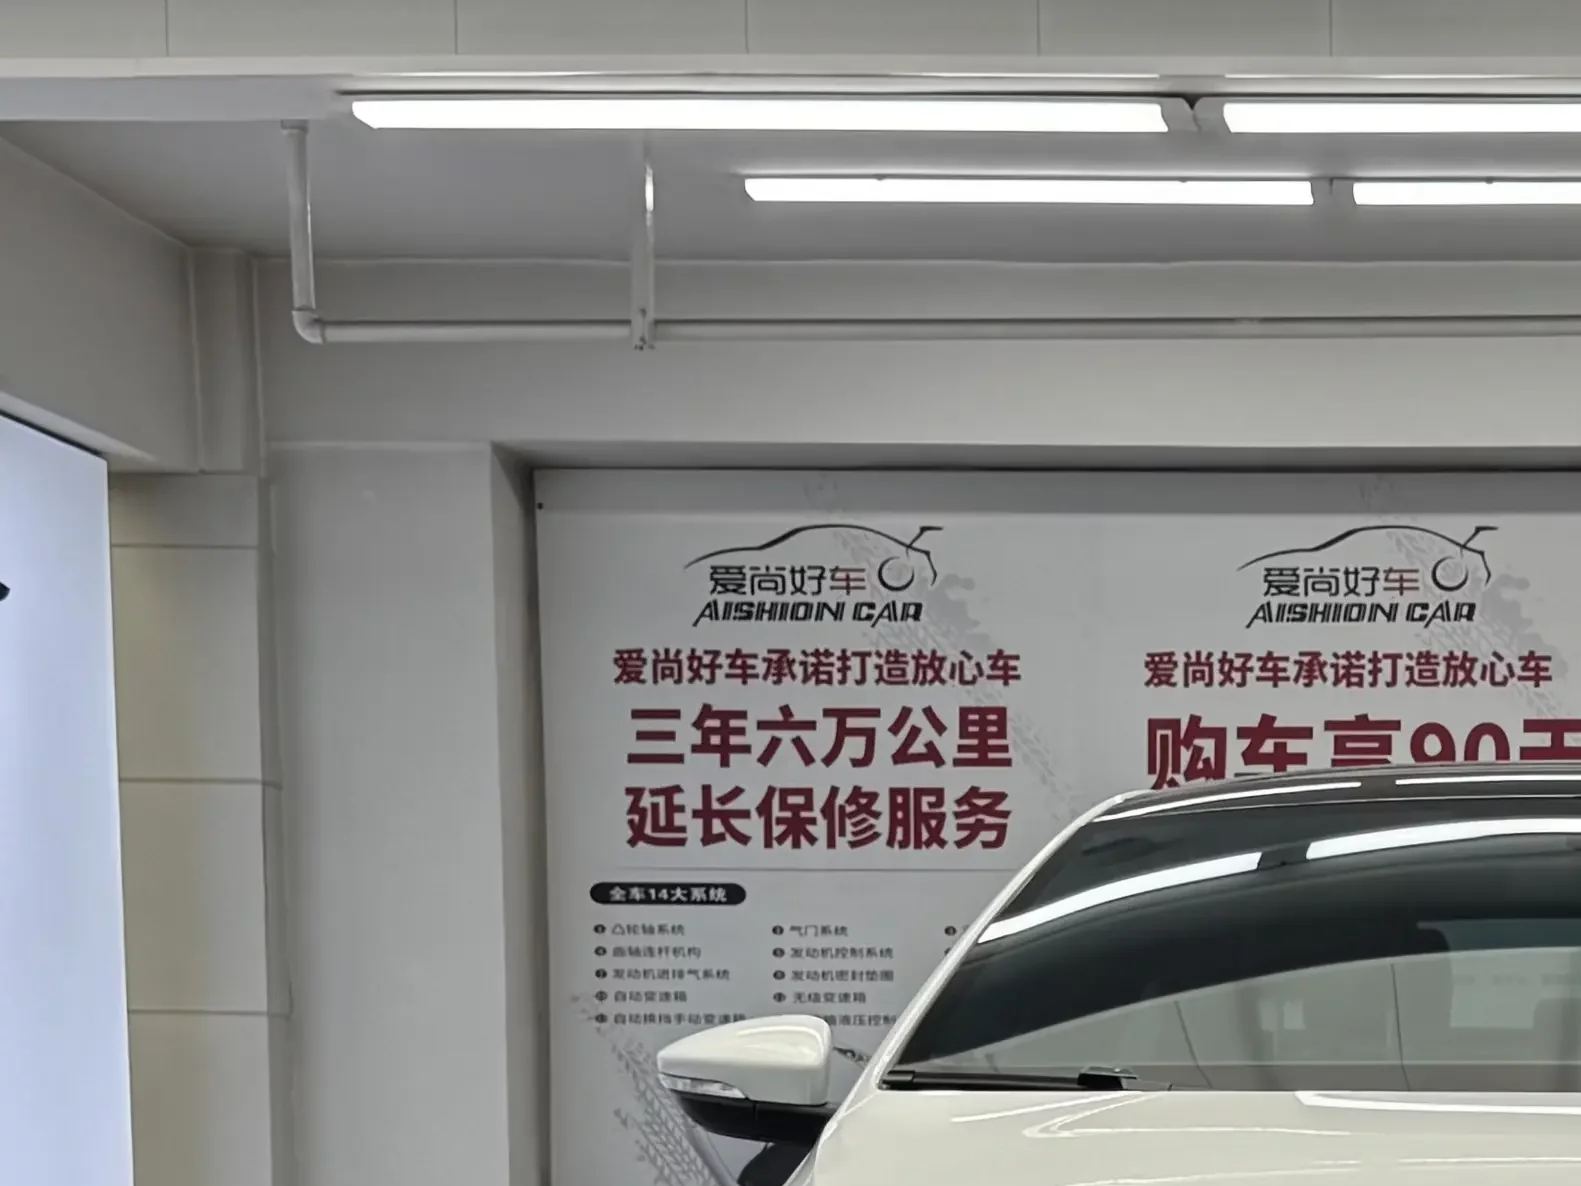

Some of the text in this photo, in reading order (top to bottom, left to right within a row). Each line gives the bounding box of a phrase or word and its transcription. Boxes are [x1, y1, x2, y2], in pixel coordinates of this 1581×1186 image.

[709, 564, 866, 597] 爱尚好车
[1263, 566, 1420, 598] 爱尚好车
[692, 598, 923, 629] AISHION CAR
[1245, 599, 1477, 629] AISHION CAR
[612, 647, 1022, 687] 爱尚好车承诺打造放心车
[1143, 649, 1553, 689] 爱尚好车承诺打造放心车
[626, 702, 1013, 769] 三年六万公里
[624, 783, 1013, 850] 延长保修服务
[609, 885, 727, 902] 全车14大系统
[789, 924, 848, 937] 气门系统
[790, 946, 894, 960] 发动机控制系统
